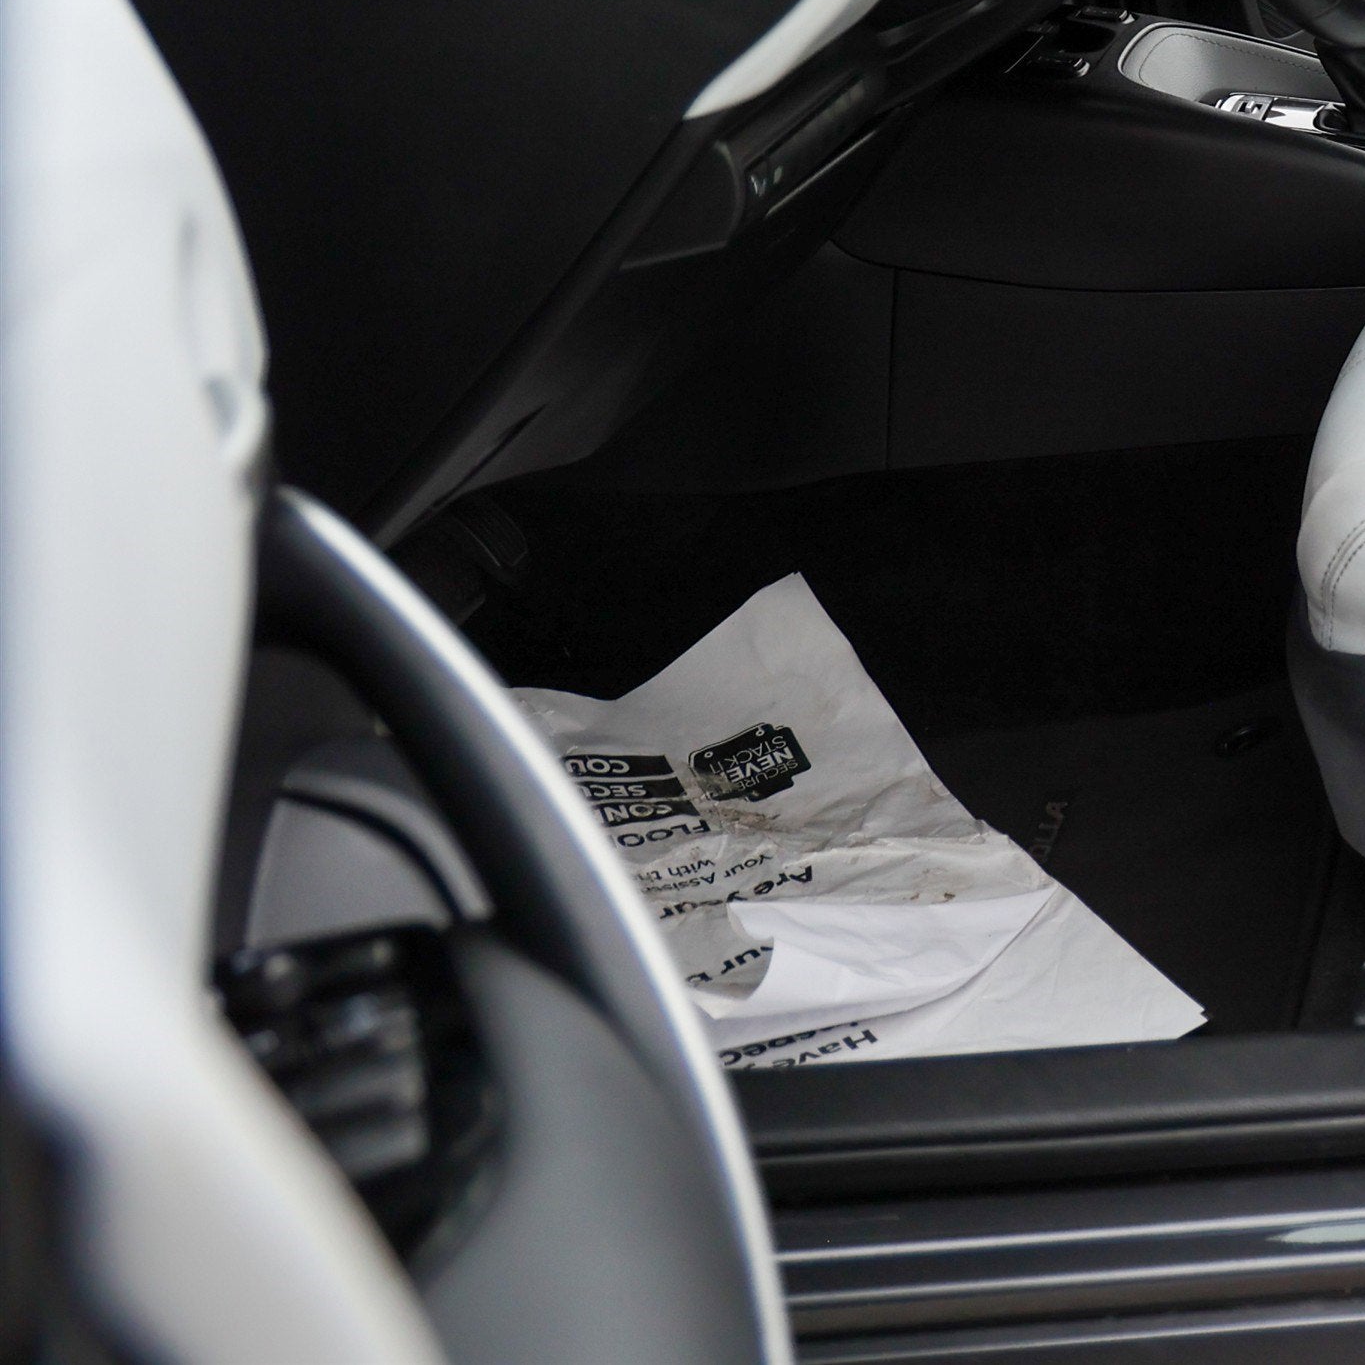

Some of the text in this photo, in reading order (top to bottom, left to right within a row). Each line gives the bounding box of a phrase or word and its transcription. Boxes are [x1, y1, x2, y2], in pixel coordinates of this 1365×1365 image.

[723, 736, 787, 772] STACK
[724, 745, 793, 783] NEVE
[737, 760, 798, 791] SECURE
[668, 857, 715, 878] with
[753, 865, 814, 895] Are
